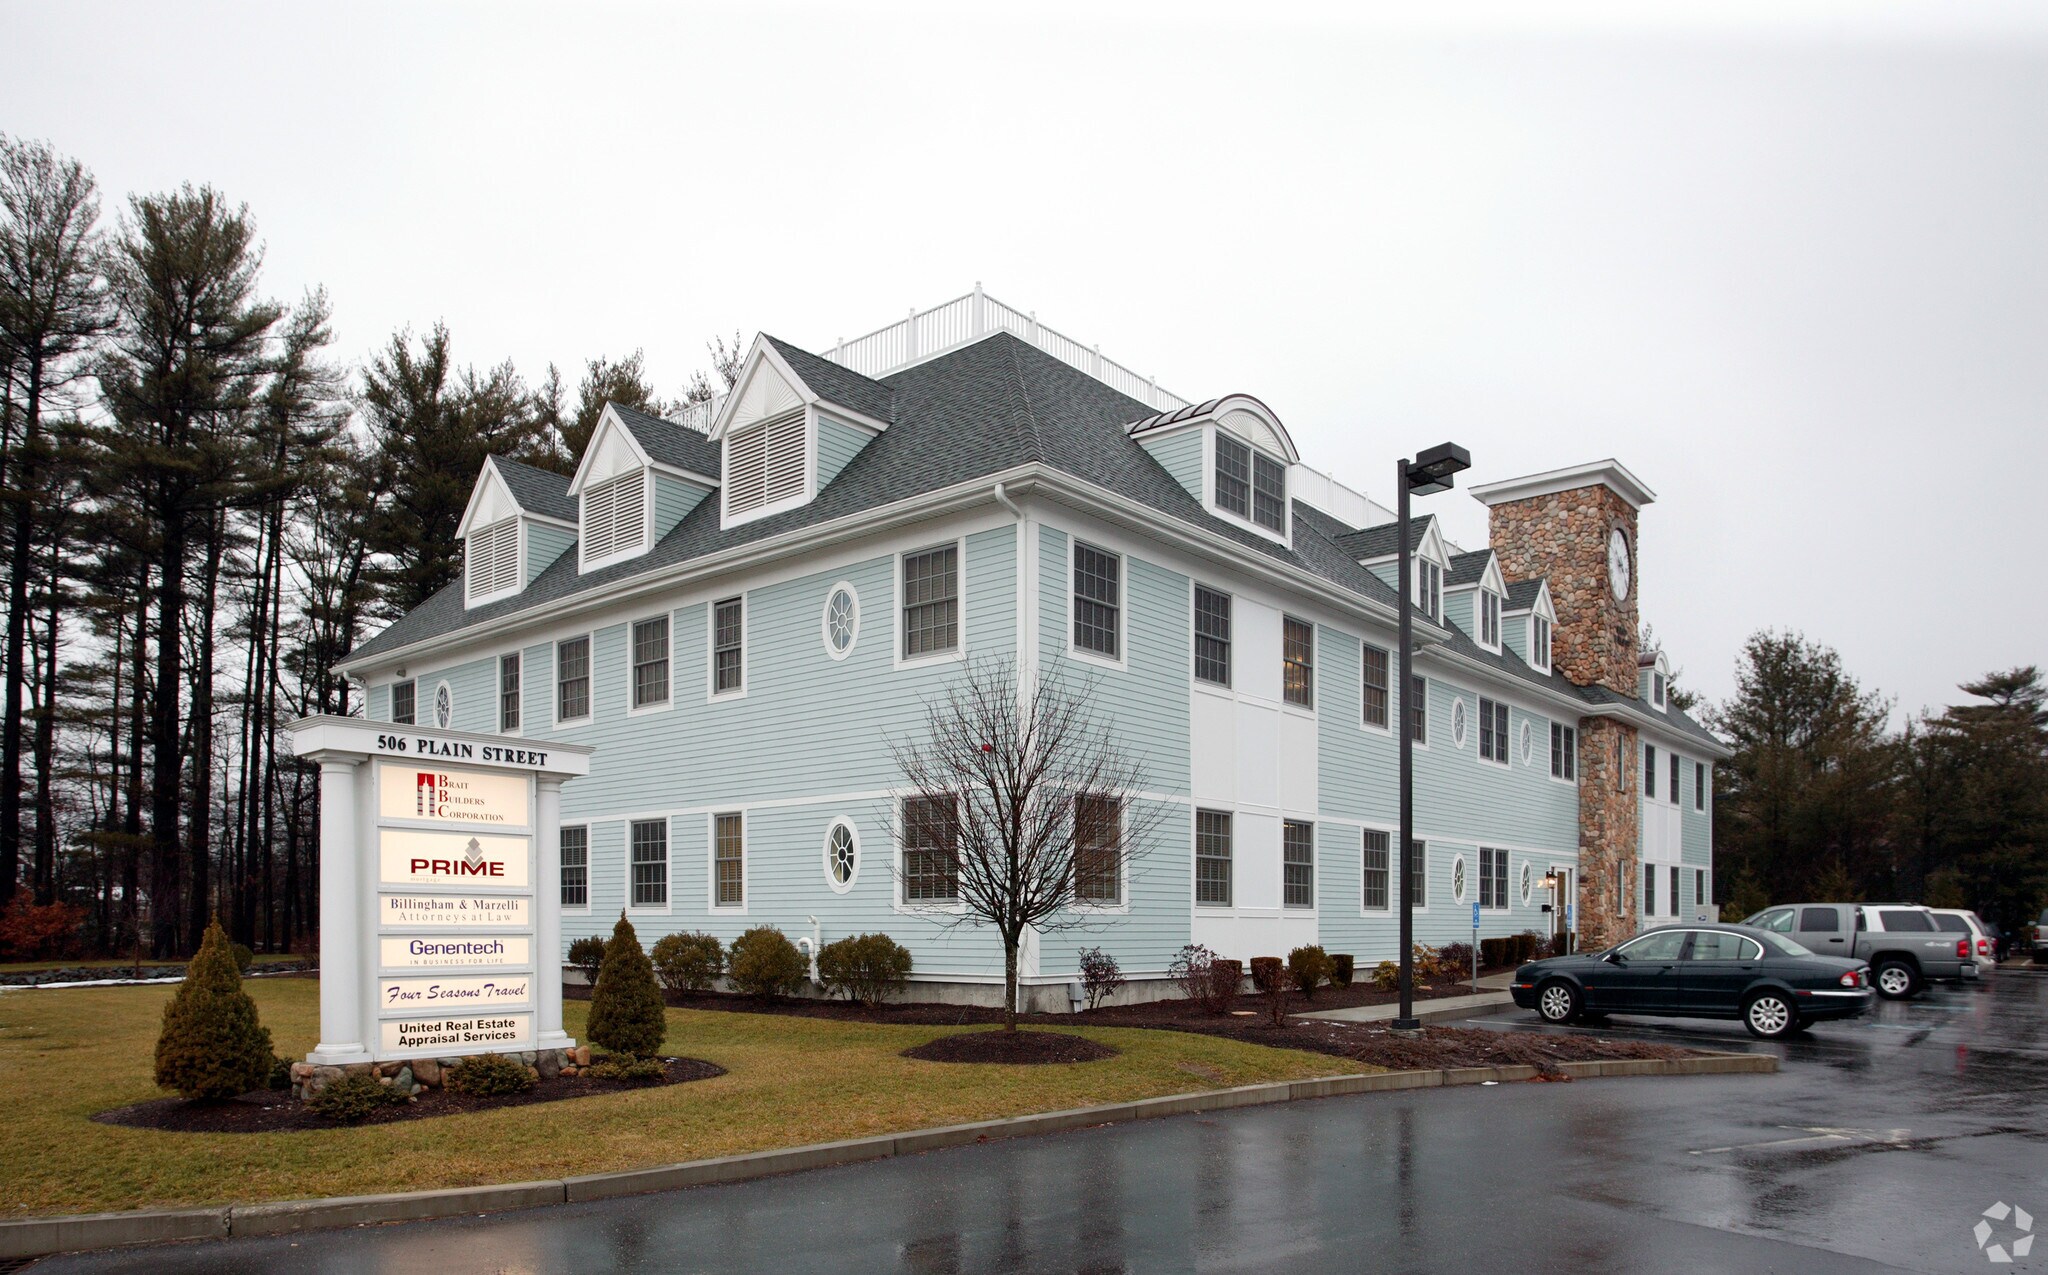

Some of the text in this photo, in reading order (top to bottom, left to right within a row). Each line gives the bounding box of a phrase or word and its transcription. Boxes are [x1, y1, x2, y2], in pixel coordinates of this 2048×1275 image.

[378, 735, 548, 766] 506 PLAIN STREET
[438, 774, 469, 789] BRAIT
[438, 789, 485, 806] BUILDERS
[438, 805, 504, 822] CORPORATION
[411, 858, 504, 876] PRIME
[391, 898, 519, 911] Billingham & Marzelli
[398, 911, 512, 923] Attorneys at Law
[410, 939, 504, 955] Genentech
[387, 983, 526, 1003] Four Seasons Travel
[399, 1018, 516, 1034] United Real Estate
[398, 1029, 516, 1048] Appraisal Services
